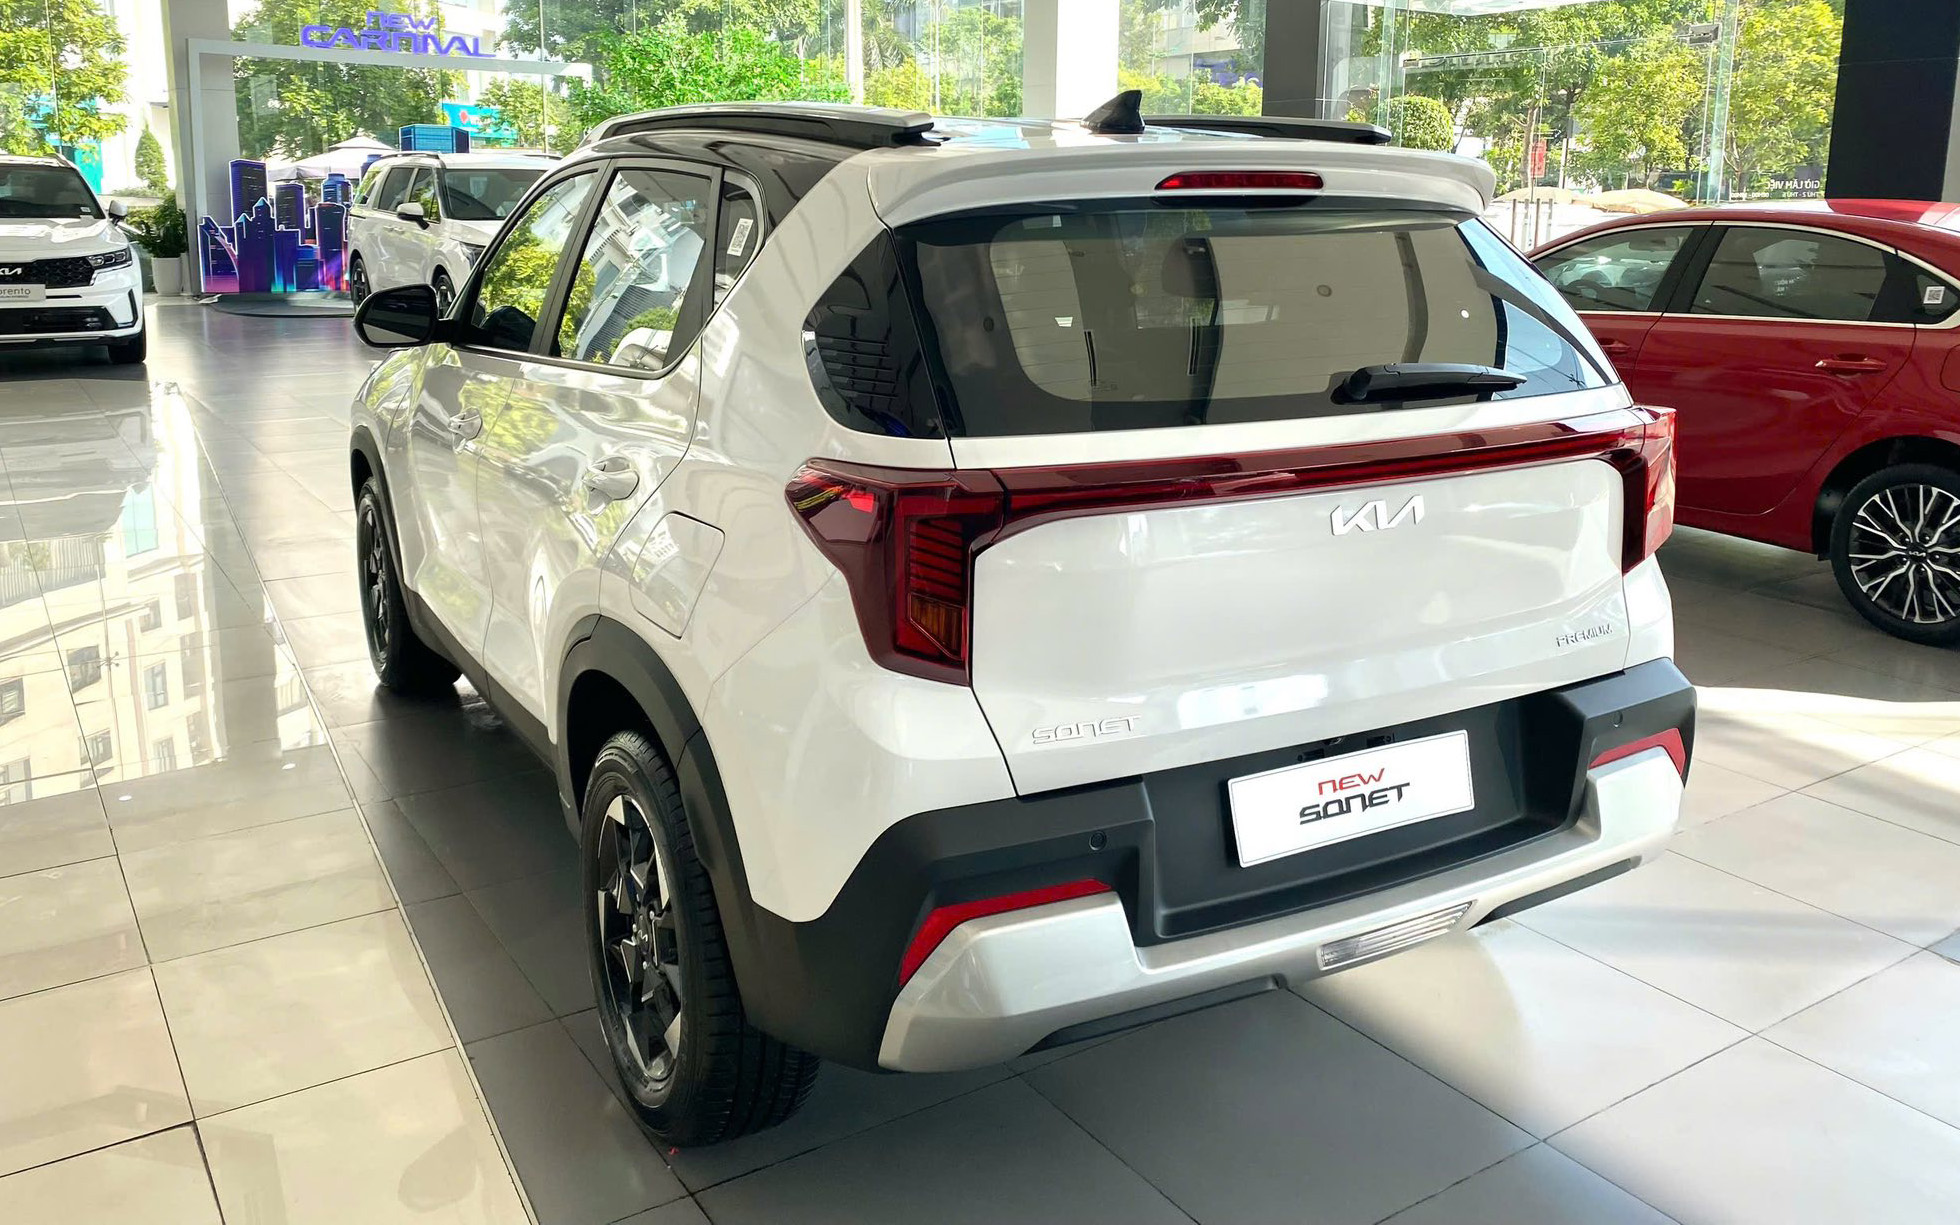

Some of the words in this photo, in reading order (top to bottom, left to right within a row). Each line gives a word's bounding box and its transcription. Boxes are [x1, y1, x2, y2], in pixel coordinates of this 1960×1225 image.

[301, 25, 496, 57] CARNIVAL
[1330, 494, 1425, 536] KIA
[1555, 622, 1614, 648] PREMIUM
[1031, 714, 1142, 745] SONET
[1318, 767, 1385, 795] NEW
[1299, 782, 1410, 825] SONET
